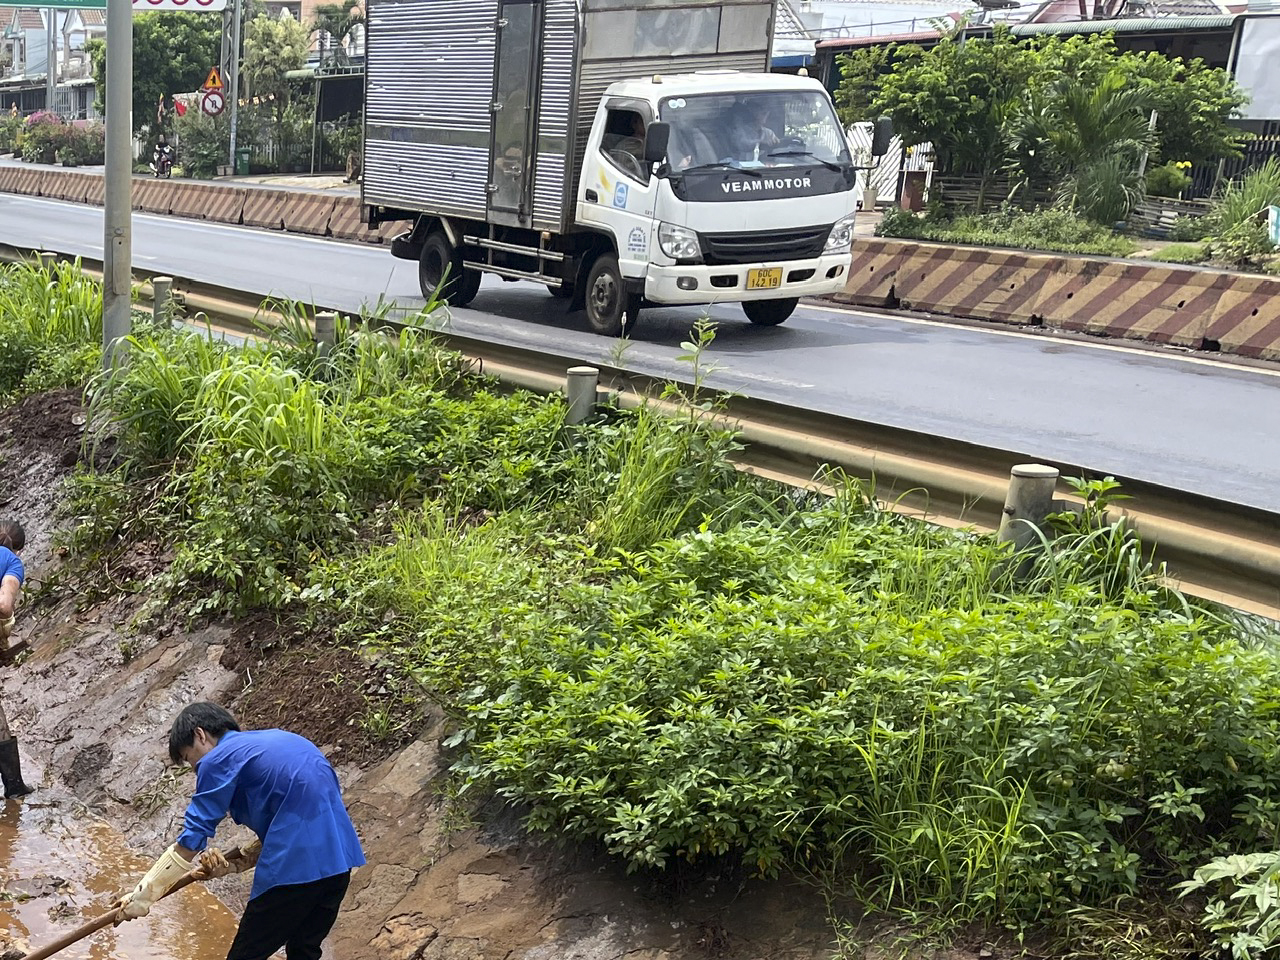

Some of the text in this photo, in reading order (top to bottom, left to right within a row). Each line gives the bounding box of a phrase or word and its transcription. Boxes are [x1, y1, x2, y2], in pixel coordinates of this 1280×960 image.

[721, 177, 811, 193] VEAM MOTOR
[757, 269, 774, 278] 60C
